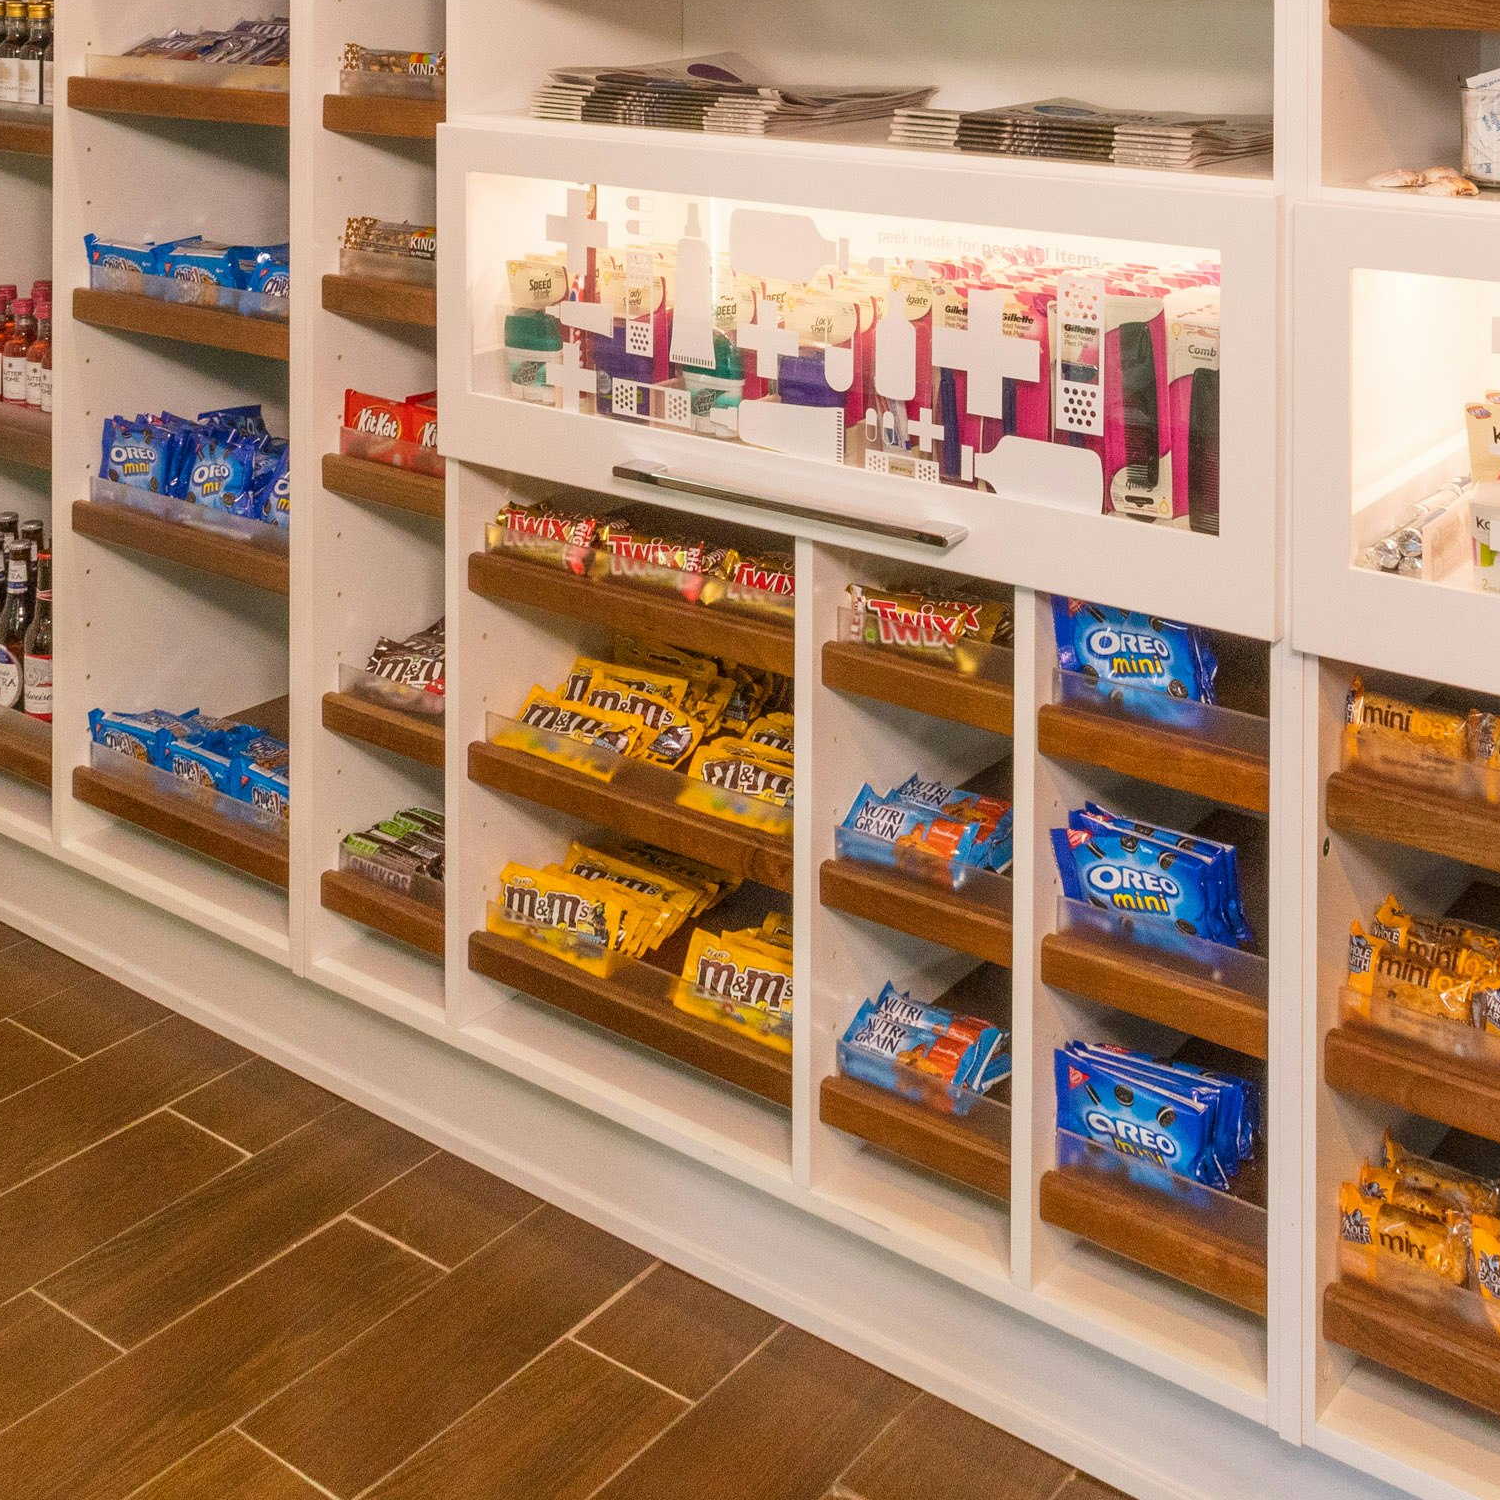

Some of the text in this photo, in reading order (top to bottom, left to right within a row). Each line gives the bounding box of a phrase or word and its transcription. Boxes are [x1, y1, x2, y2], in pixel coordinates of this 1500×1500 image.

[878, 231, 908, 245] peek
[915, 235, 952, 248] inside
[958, 237, 977, 252] for
[1188, 344, 1216, 357] Comb
[111, 446, 156, 462] OREO
[123, 463, 149, 475] mini
[1090, 629, 1169, 658] OREO
[1112, 655, 1163, 677] mini
[860, 800, 904, 825] NUTRI
[854, 816, 900, 840] GRAIN
[1089, 865, 1178, 896] OREO
[1113, 891, 1168, 916] mini
[855, 1030, 901, 1056] GRAIN
[1087, 1111, 1176, 1155] OREO
